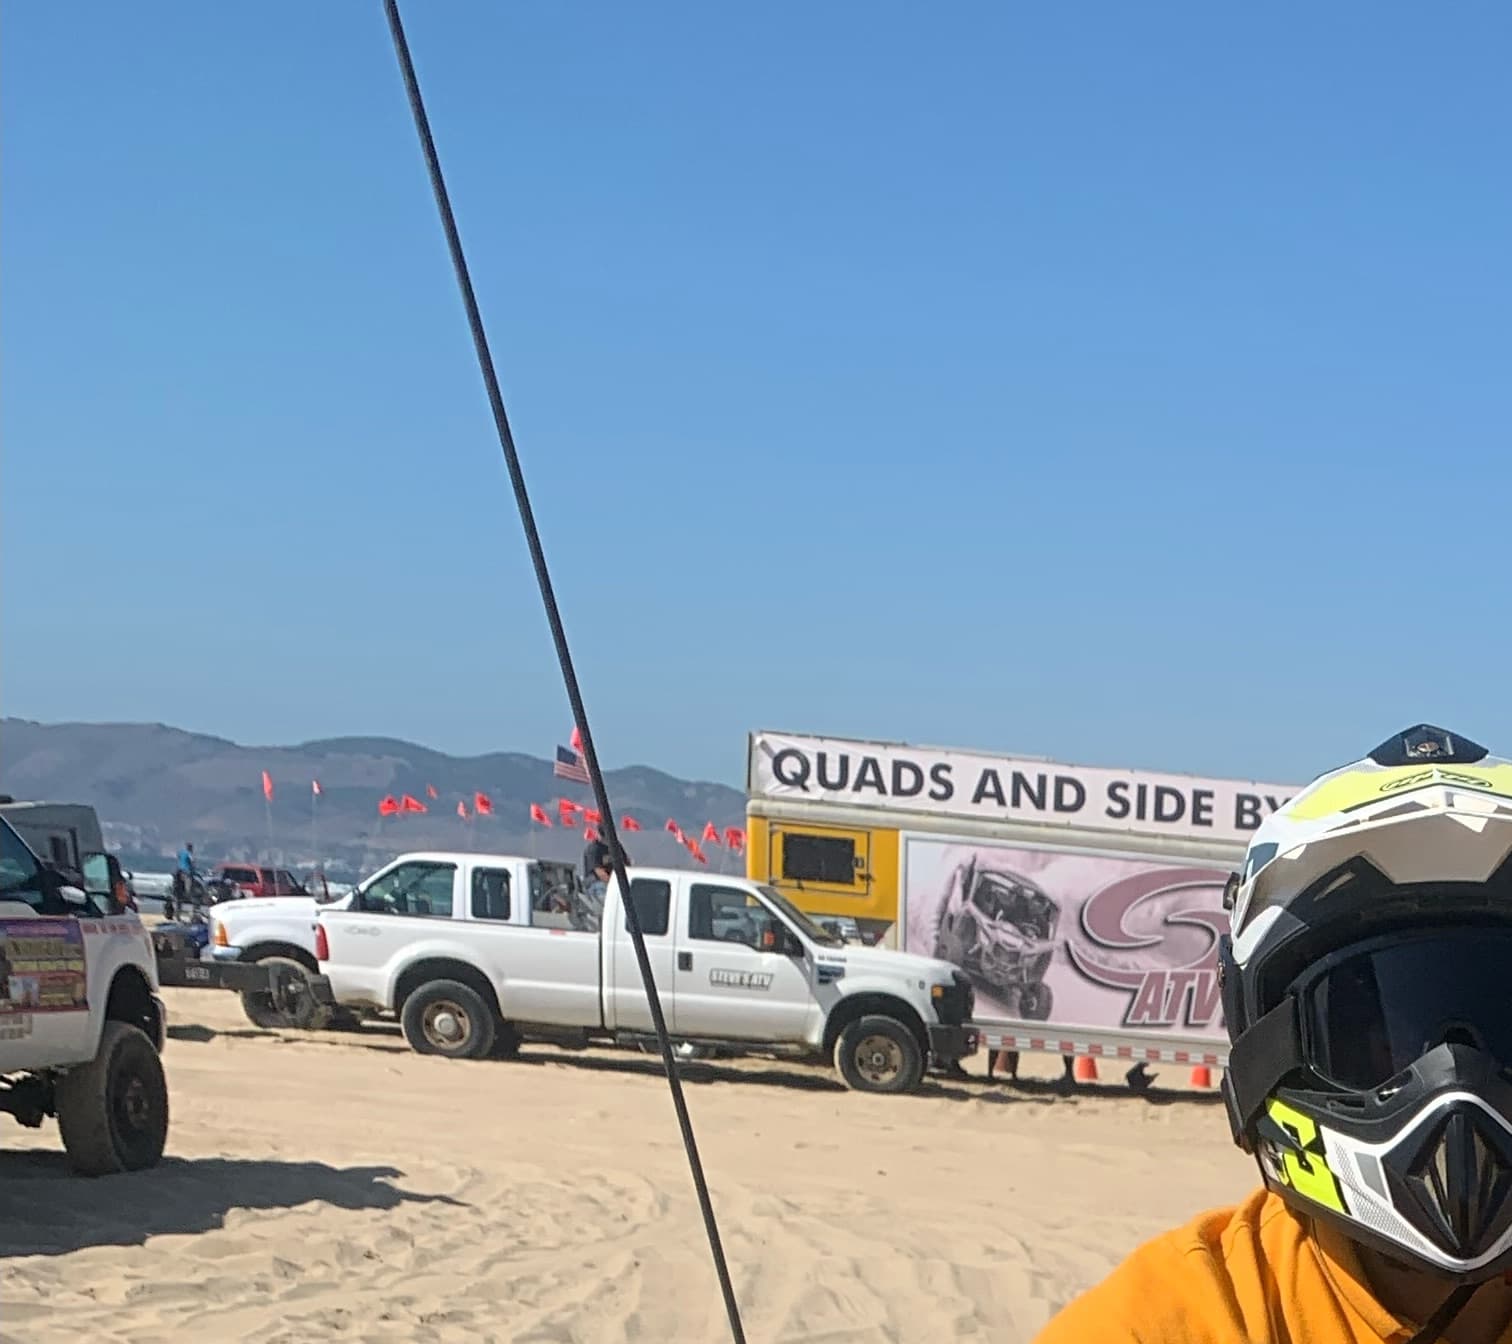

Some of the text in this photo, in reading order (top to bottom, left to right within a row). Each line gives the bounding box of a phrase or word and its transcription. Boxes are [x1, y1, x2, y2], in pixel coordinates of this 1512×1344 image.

[772, 748, 955, 801] QUADS
[971, 767, 1087, 813] AND
[1104, 781, 1215, 827] SIDE
